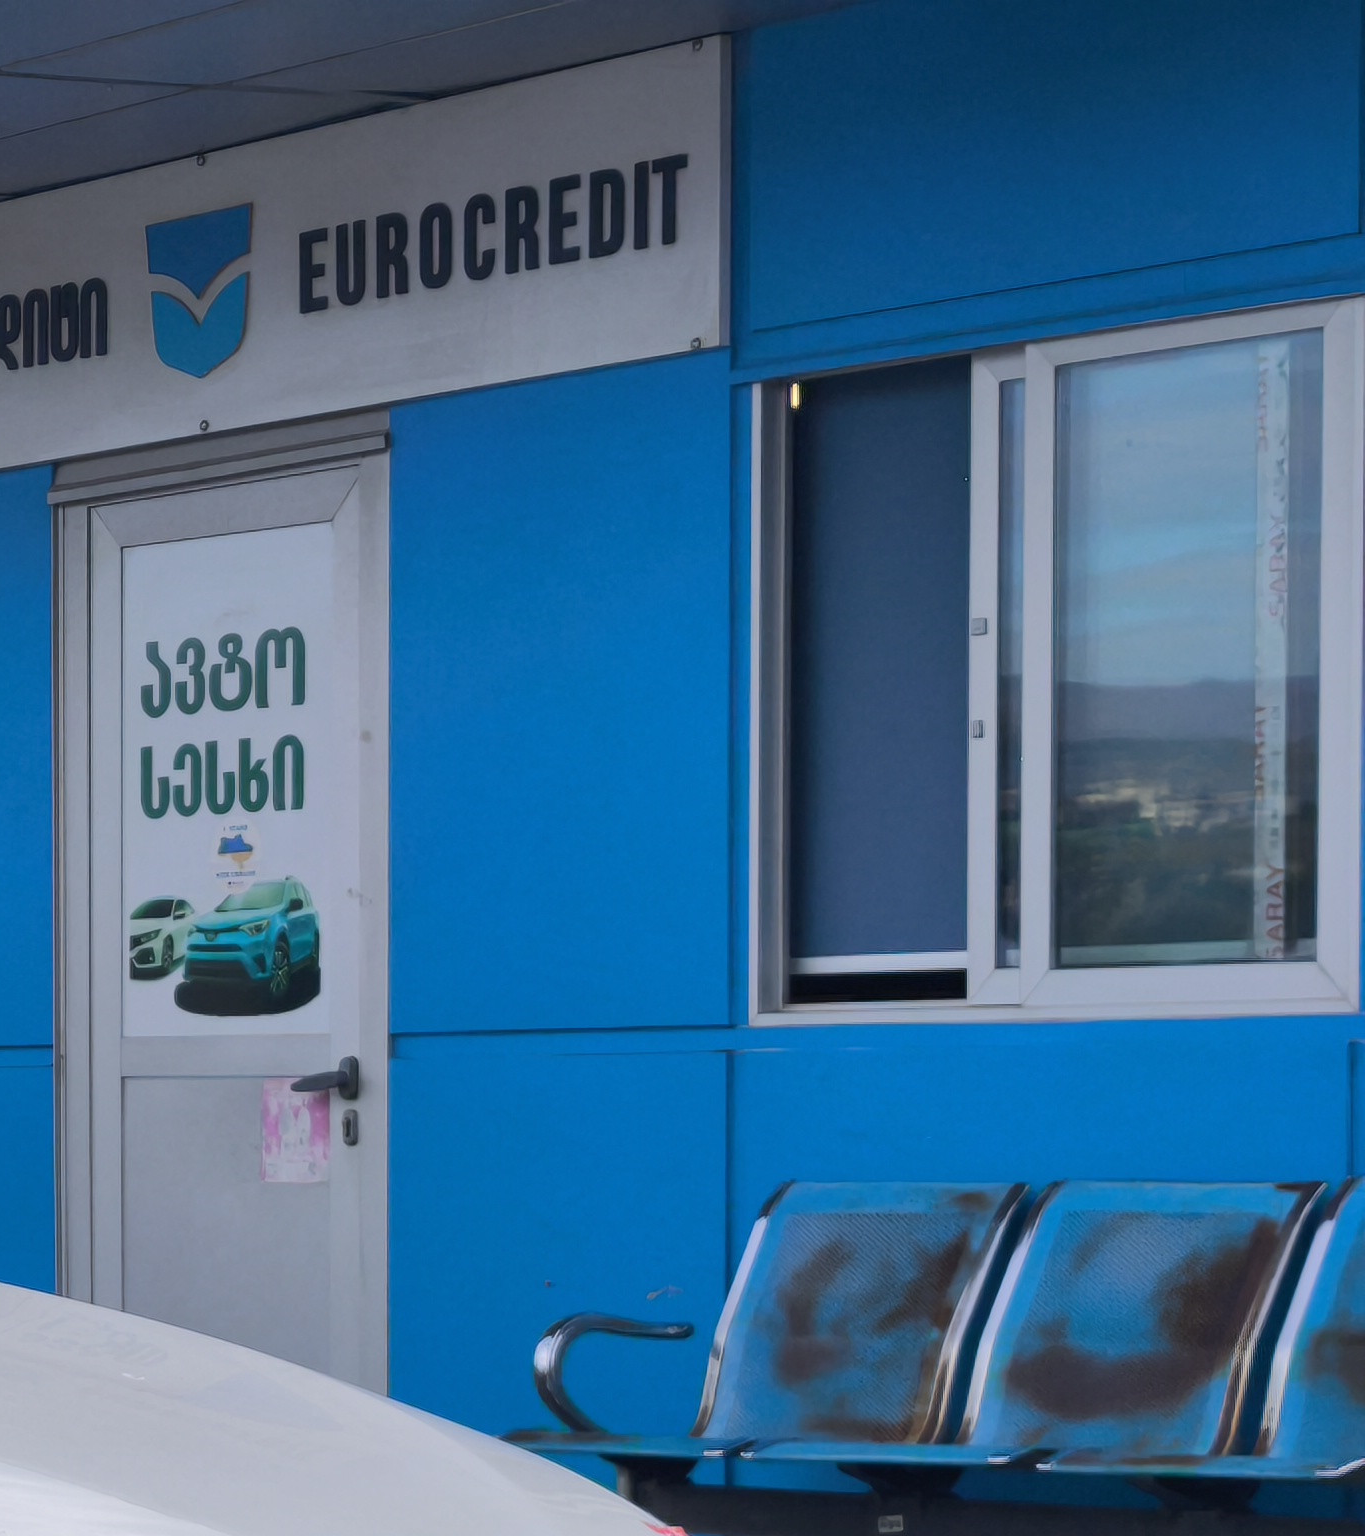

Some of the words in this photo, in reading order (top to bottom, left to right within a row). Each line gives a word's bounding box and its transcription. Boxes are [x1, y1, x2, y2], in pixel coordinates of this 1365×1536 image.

[299, 153, 689, 315] EUROCREDIT
[140, 625, 307, 719] ავტო
[140, 734, 306, 820] სესხი
